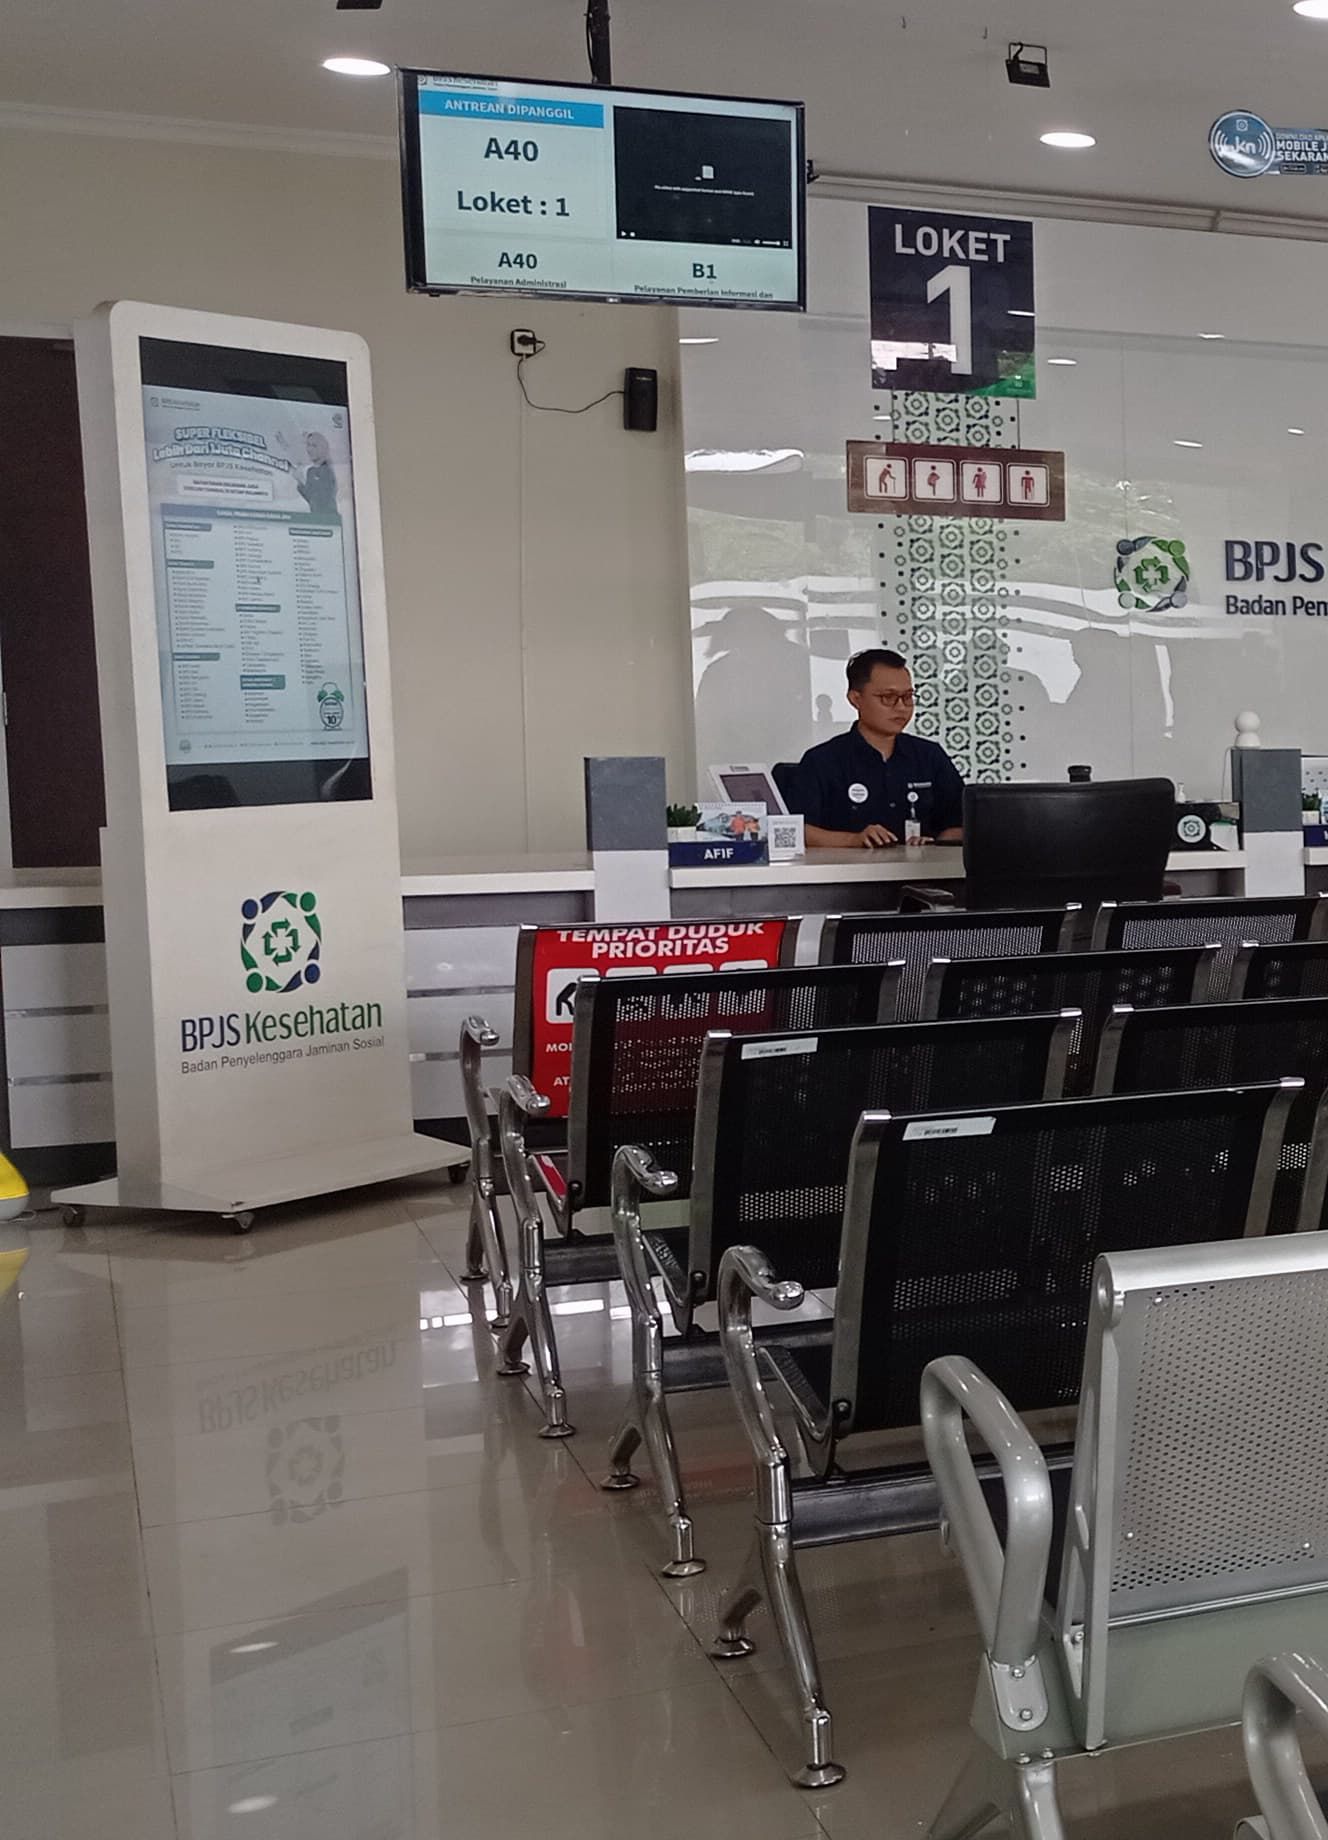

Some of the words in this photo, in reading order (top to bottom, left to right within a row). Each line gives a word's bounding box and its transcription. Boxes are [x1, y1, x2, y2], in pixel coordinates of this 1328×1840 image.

[445, 100, 504, 114] ANTREAN
[508, 104, 574, 120] DIPANGGIL
[484, 138, 539, 161] A40
[1276, 140, 1319, 151] MOBILE
[457, 190, 532, 215] Loket
[556, 198, 570, 216] 1
[895, 224, 1011, 263] LOKET
[498, 252, 538, 269] A40
[692, 263, 717, 279] B1
[927, 265, 972, 375] 1
[174, 426, 211, 441] SUPER
[1224, 540, 1324, 583] BPJS
[1225, 595, 1286, 616] Badan
[704, 848, 734, 860] AFIF
[557, 927, 663, 943] TEMPAT
[667, 923, 764, 939] DUDUK
[592, 937, 730, 959] PRIORITAS
[181, 1013, 241, 1052] BPJS
[245, 1002, 382, 1044] Kesehatan
[181, 1060, 218, 1074] Badan
[221, 1048, 303, 1068] Penyelenggara
[305, 1042, 350, 1057] Jaminan
[353, 1036, 385, 1051] Sosial
